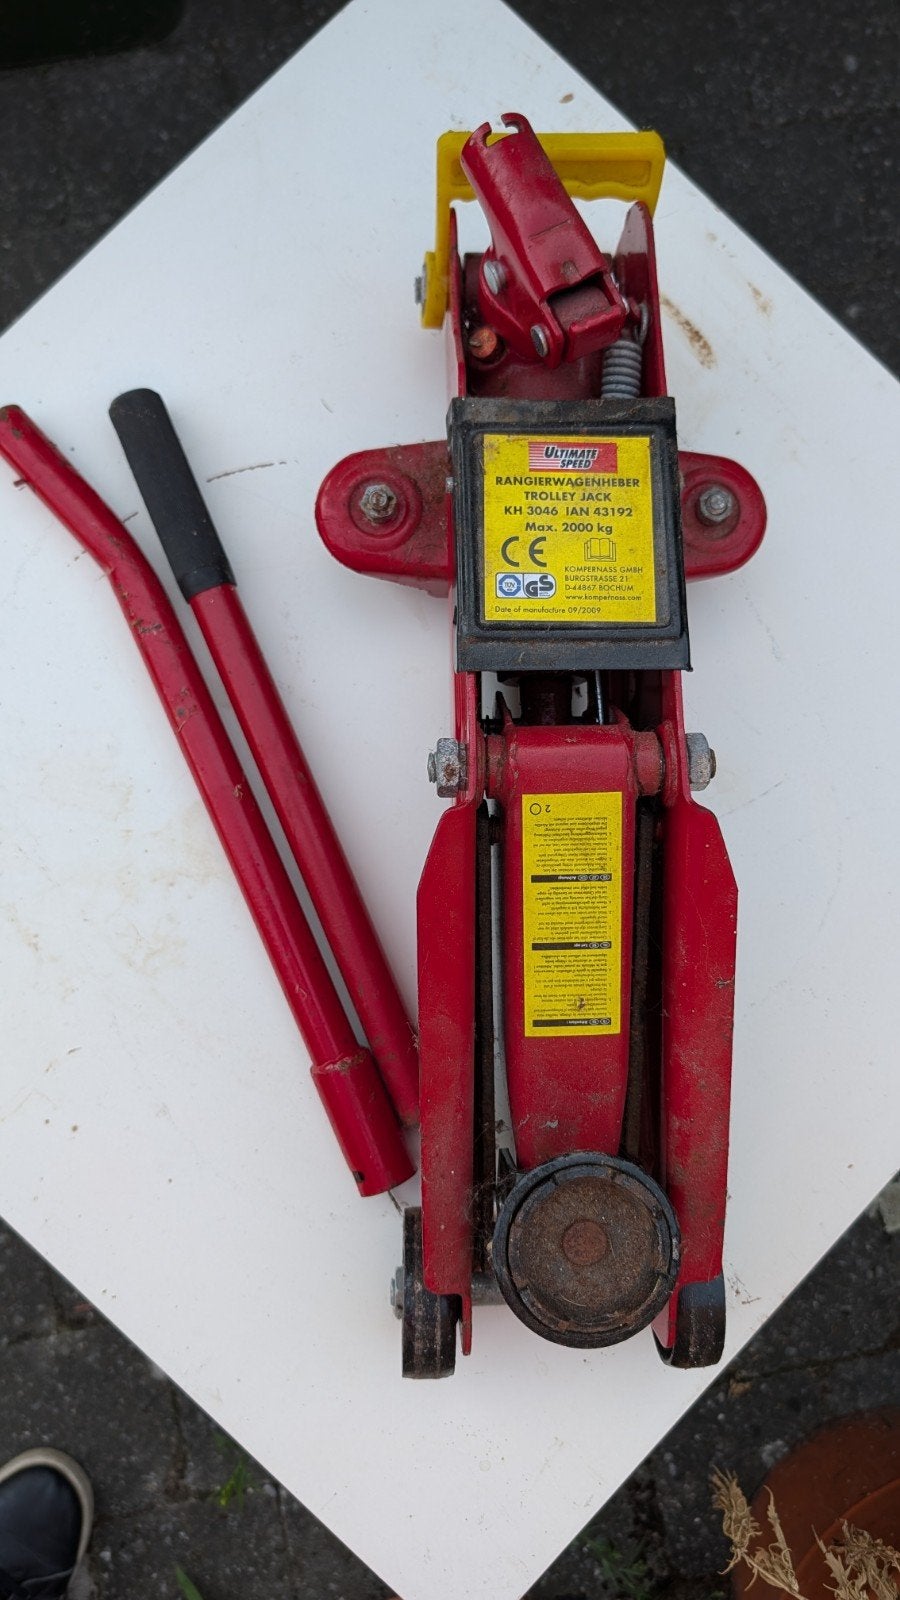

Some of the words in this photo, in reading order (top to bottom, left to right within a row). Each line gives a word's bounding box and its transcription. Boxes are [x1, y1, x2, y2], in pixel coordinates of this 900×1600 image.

[545, 446, 598, 459] ULTIMATE
[560, 460, 591, 469] SPEED
[495, 476, 640, 488] RANGIERWAGENHEBER
[524, 492, 576, 501] TROLLEY
[580, 492, 612, 502] JACK
[504, 506, 523, 515] KH
[527, 506, 558, 516] 3046
[566, 507, 590, 516] IAN
[593, 507, 633, 517] 43192
[525, 522, 558, 532] Max.
[562, 522, 594, 532] 2000
[597, 523, 613, 536] kg
[568, 606, 602, 614] 09/2009
